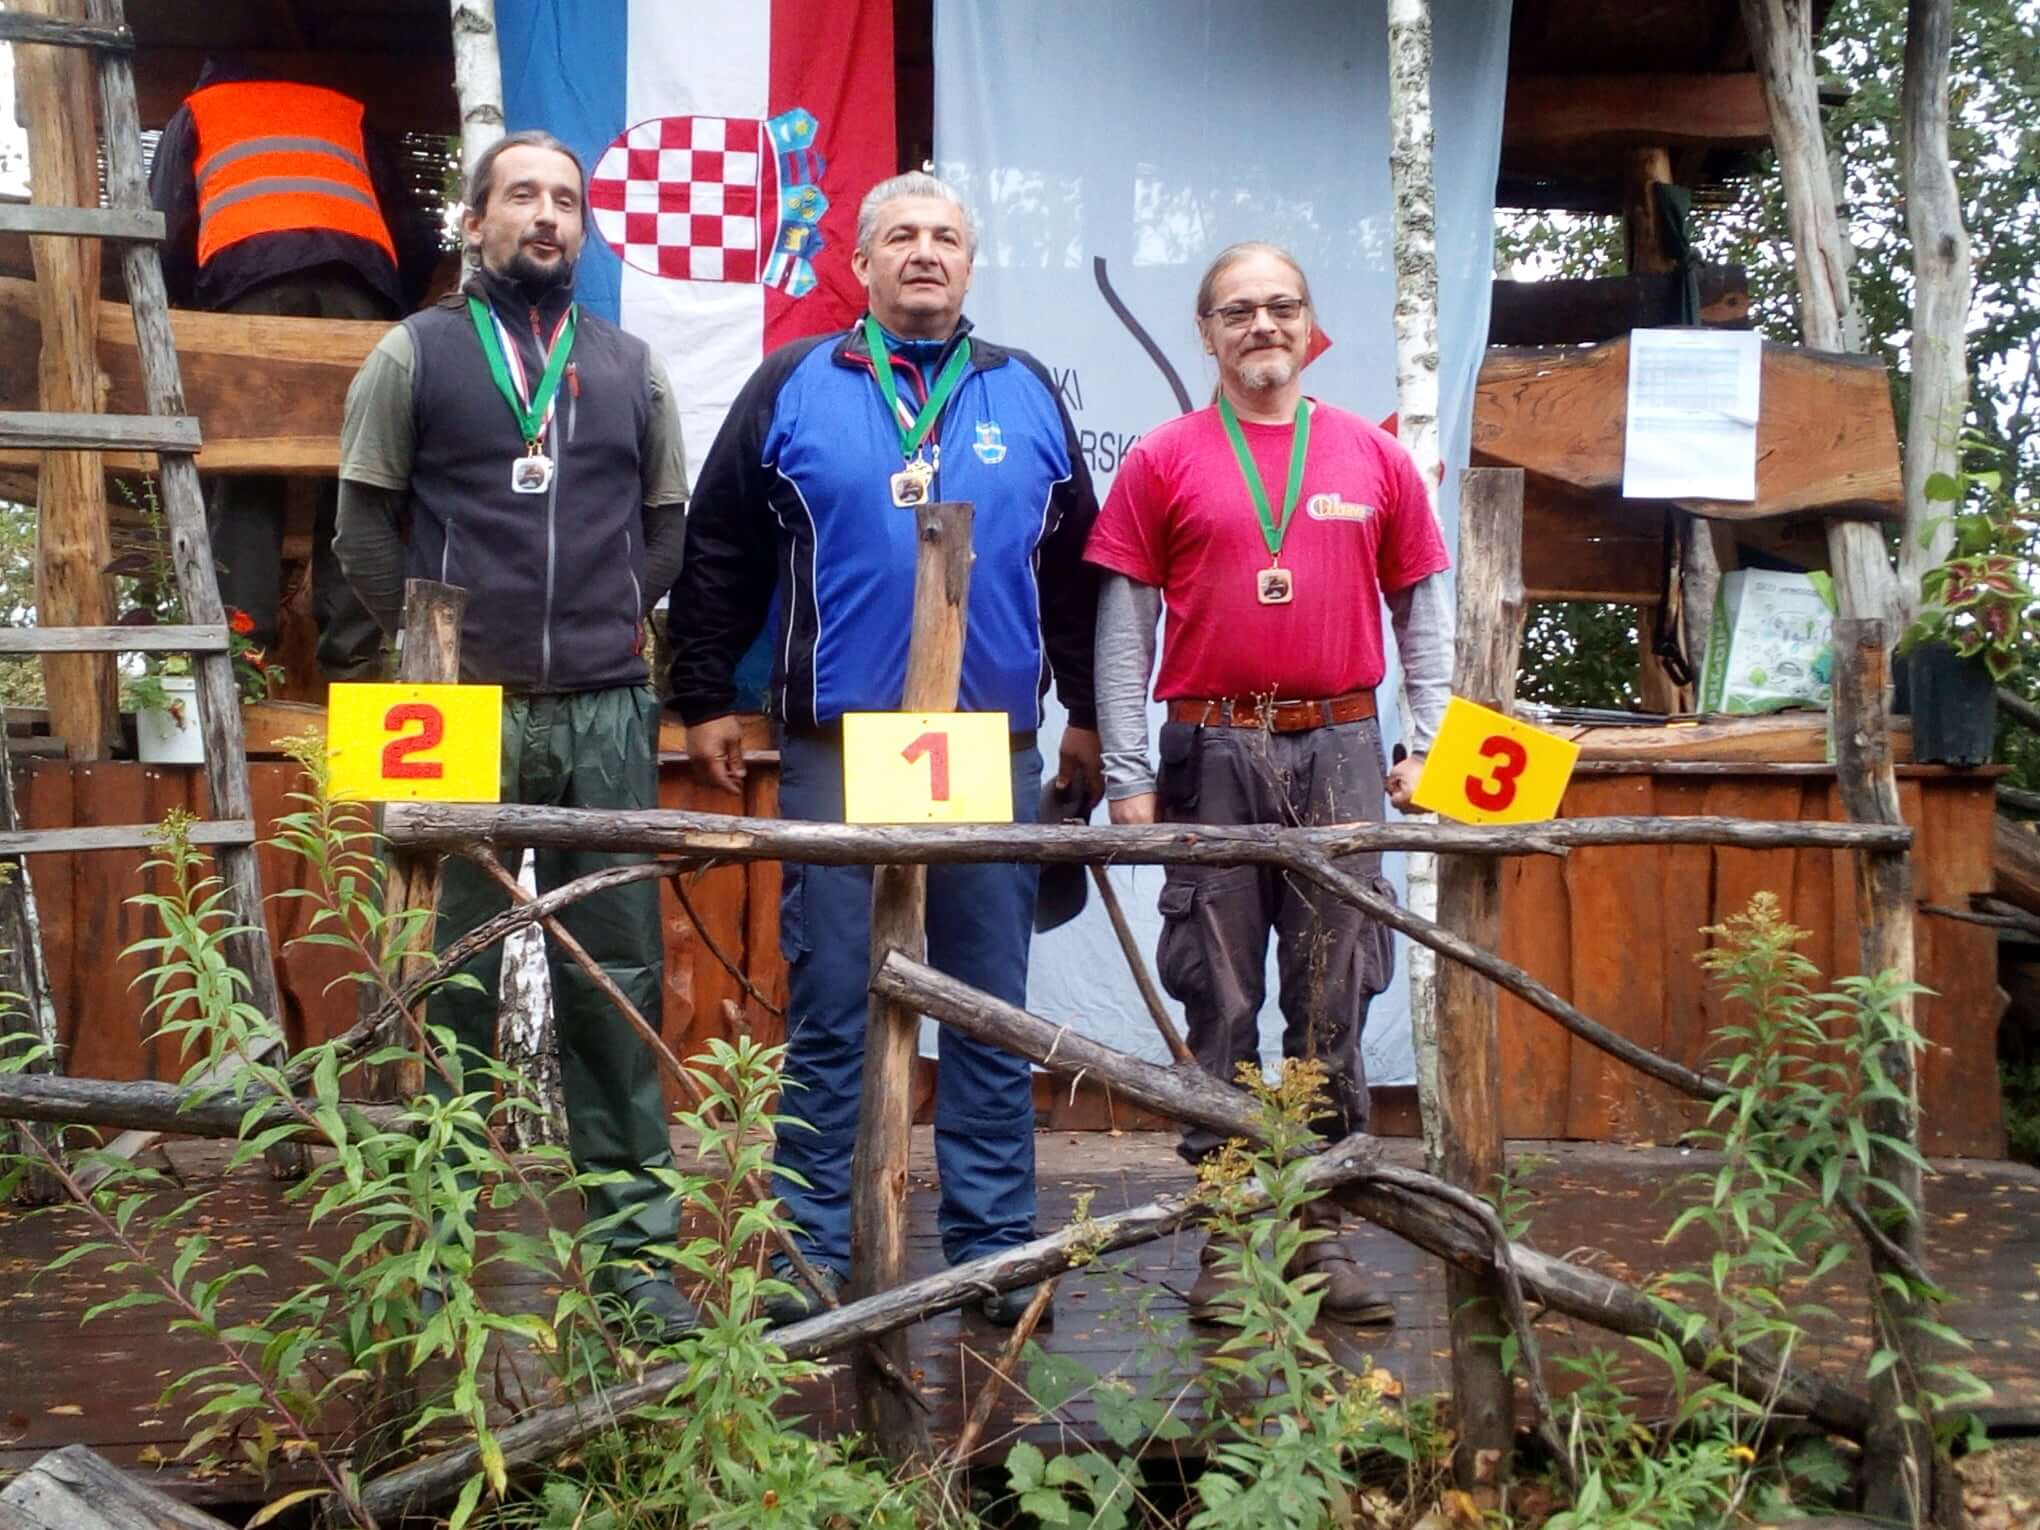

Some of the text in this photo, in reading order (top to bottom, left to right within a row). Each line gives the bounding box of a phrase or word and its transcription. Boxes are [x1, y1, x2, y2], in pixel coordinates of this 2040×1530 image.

[1053, 367, 1083, 411] KI
[1080, 429, 1142, 473] RSK
[382, 703, 443, 779] 2
[901, 732, 949, 801] 1
[1465, 735, 1527, 812] 3
